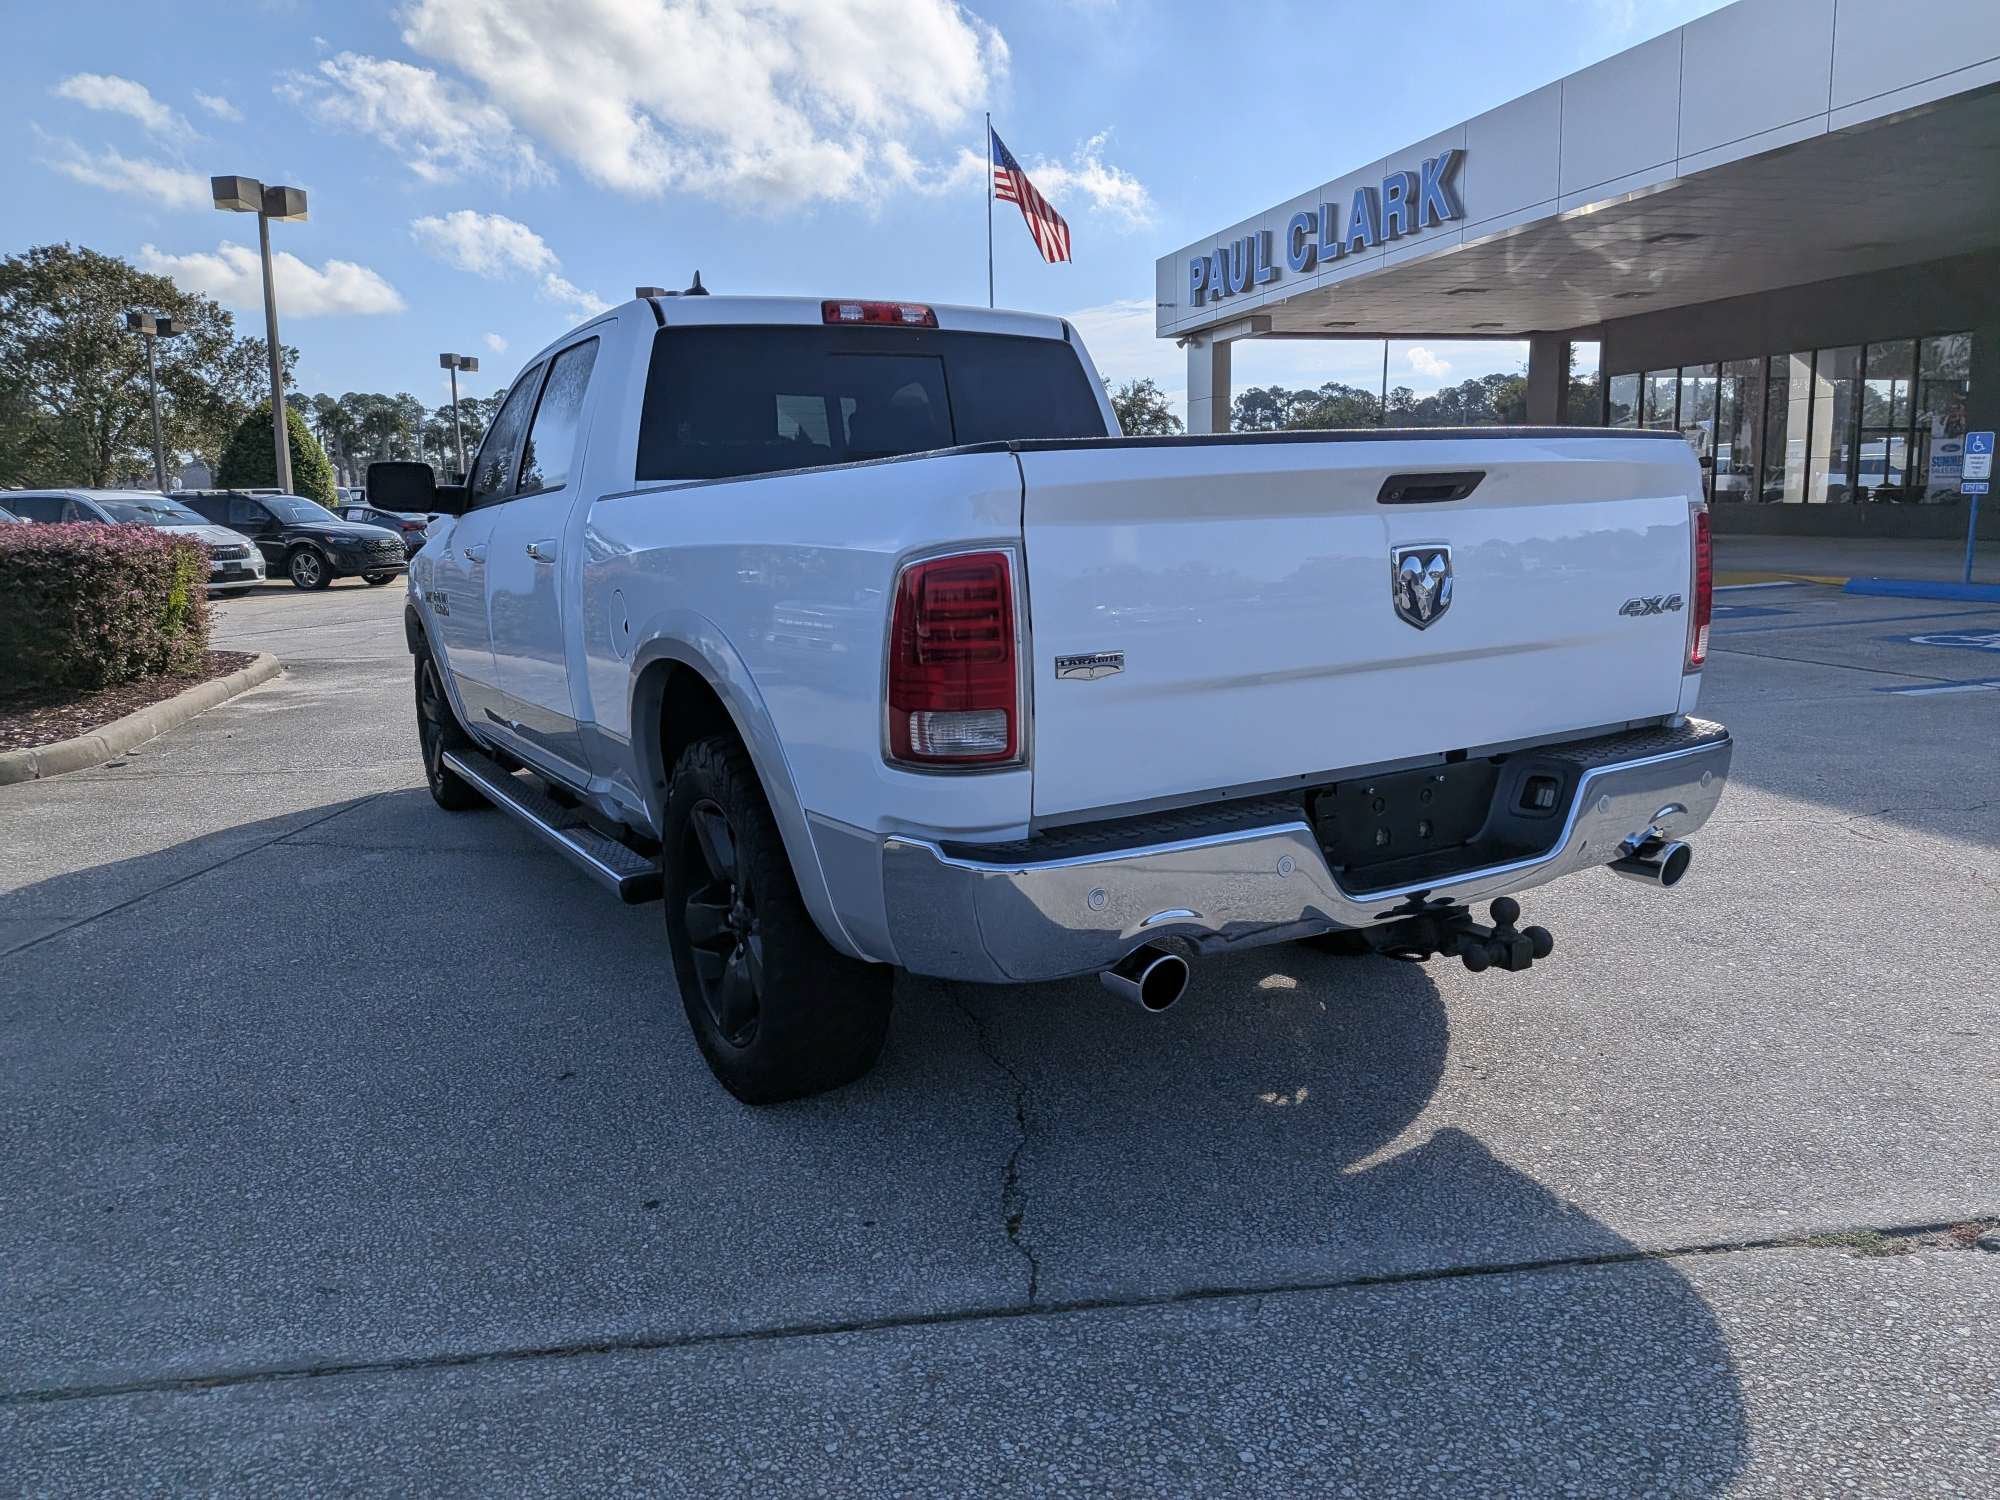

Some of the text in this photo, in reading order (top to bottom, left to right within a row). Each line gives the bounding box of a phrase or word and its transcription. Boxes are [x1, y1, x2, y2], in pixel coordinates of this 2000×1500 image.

[1189, 149, 1465, 306] PAUL CLARK
[1060, 655, 1121, 666] LARAMIE
